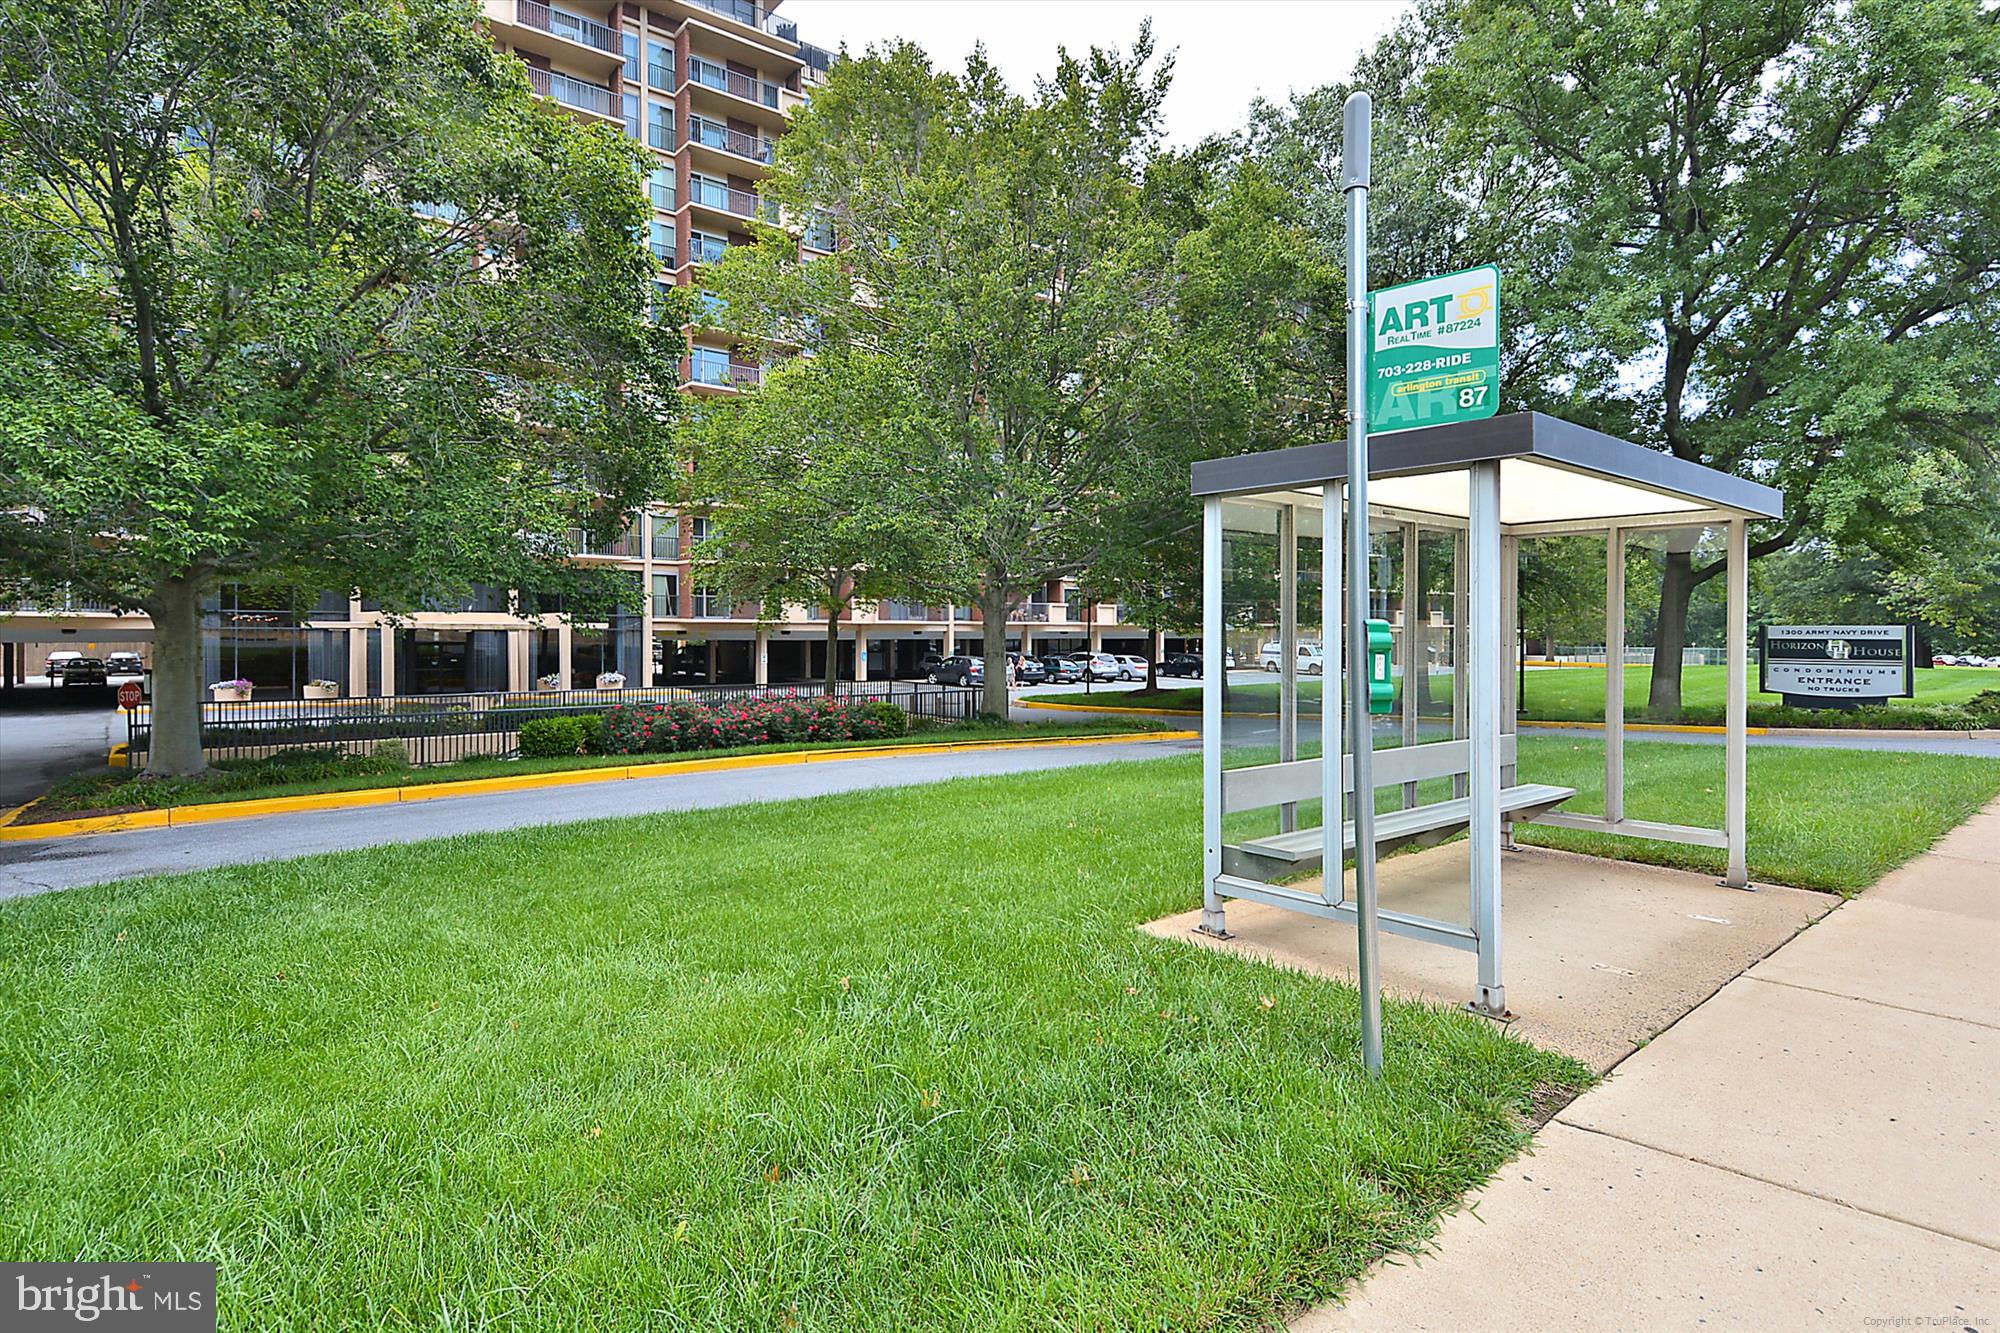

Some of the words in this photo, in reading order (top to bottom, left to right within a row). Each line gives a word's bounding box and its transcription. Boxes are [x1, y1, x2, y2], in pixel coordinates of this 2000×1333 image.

[1378, 294, 1454, 336] ART
[1437, 318, 1481, 335] #87224
[1377, 352, 1472, 379] 703-228-RIDE
[1397, 379, 1442, 393] arlington
[1445, 371, 1480, 385] transit
[1459, 385, 1489, 408] 87
[1770, 640, 1825, 651] HORIZON
[1853, 646, 1901, 657] HOUSE
[1773, 667, 1897, 675] CONDOMINIUMS
[1797, 677, 1872, 686] ENTRANCE
[120, 690, 140, 702] STOP
